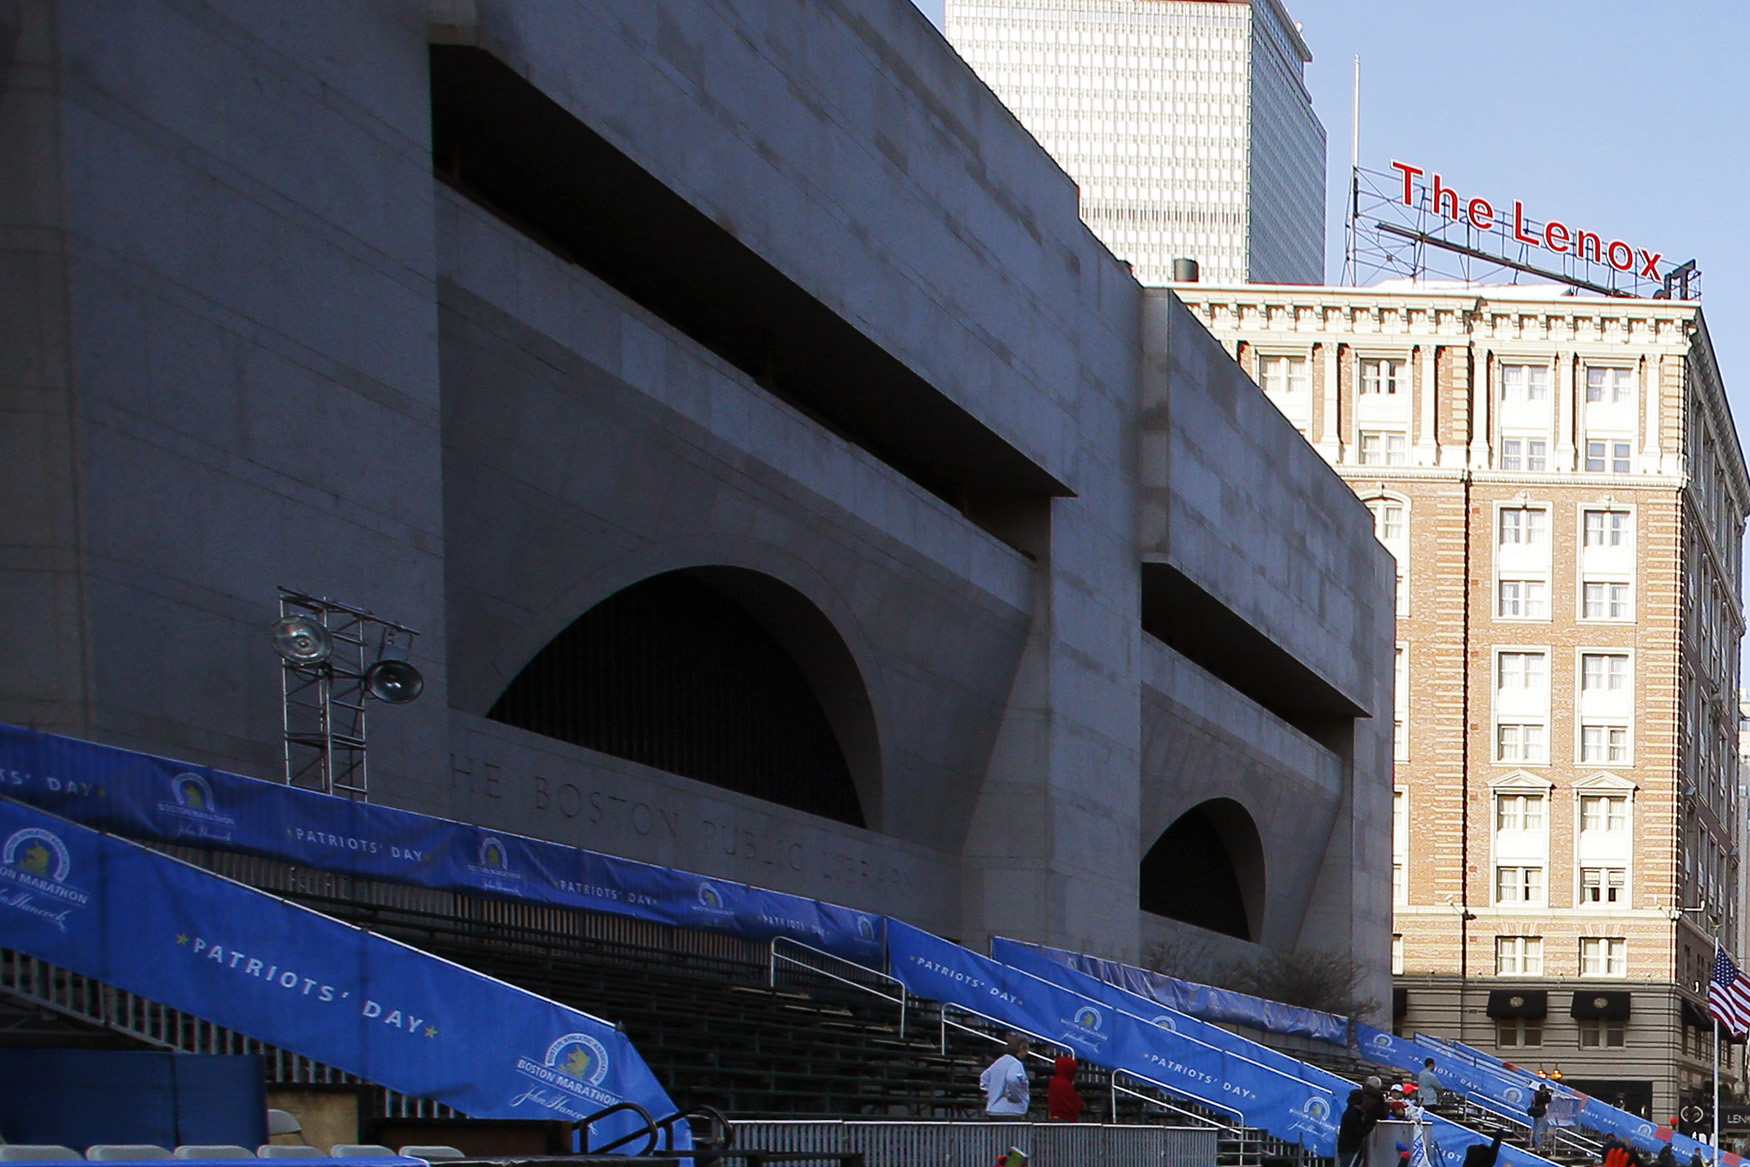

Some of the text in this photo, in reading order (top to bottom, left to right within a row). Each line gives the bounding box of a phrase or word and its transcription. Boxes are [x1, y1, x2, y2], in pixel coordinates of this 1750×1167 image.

[1391, 160, 1495, 230] The
[1511, 199, 1665, 283] Lenox
[296, 828, 424, 862] PATRIOTS' DAY
[20, 873, 88, 904] MARATHON
[194, 936, 425, 1034] PATRIOTS' DAY
[917, 957, 1016, 1004] PATRIOTS' DAY
[517, 1058, 556, 1083] BOSTON
[555, 1075, 621, 1105] MARATHON
[1151, 1054, 1250, 1098] PATRIOTS' DAY
